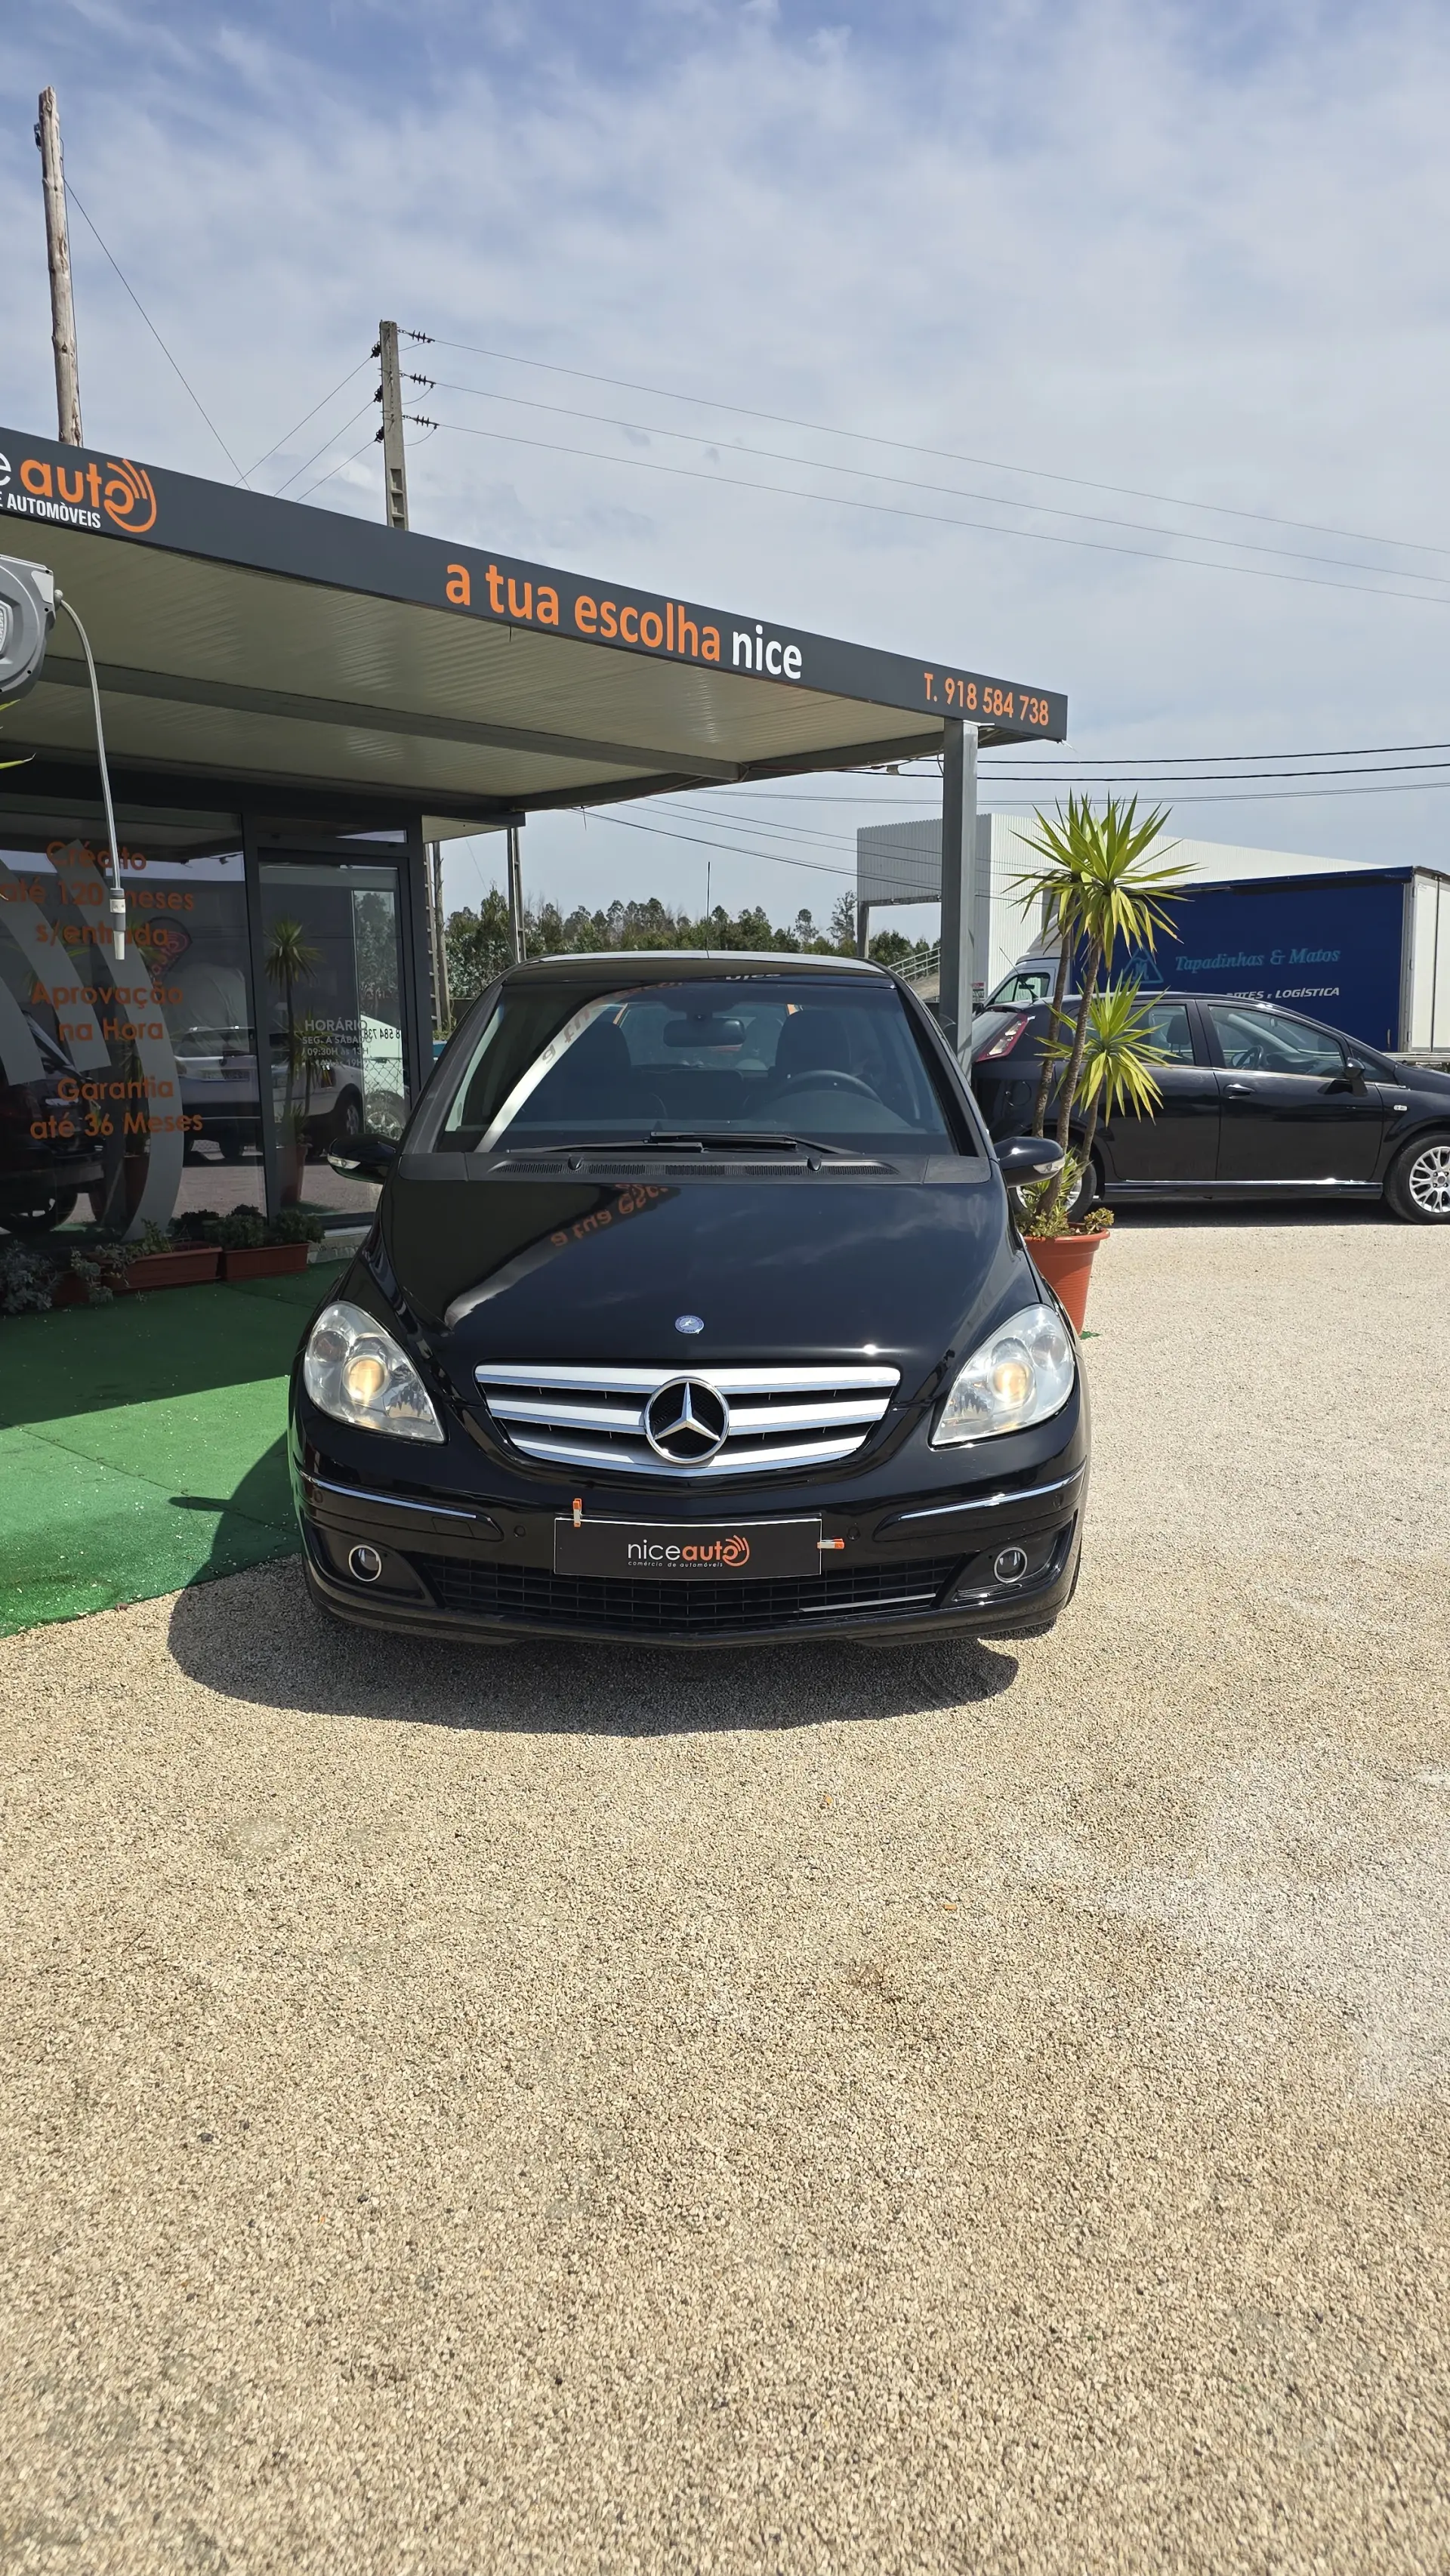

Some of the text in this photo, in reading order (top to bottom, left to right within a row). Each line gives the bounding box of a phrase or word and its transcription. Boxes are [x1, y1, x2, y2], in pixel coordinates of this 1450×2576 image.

[446, 564, 802, 679] a tua escolha nice
[924, 672, 1049, 726] T. 918 584 738
[57, 879, 103, 907] 120
[1175, 948, 1341, 974] Tapadinhas & Matos
[31, 981, 184, 1010] Aprovação
[59, 1018, 163, 1041] na Hora
[304, 1017, 368, 1031] HORÁRIO
[57, 1076, 174, 1101] Garantia
[30, 1111, 203, 1139] até 36 Meses
